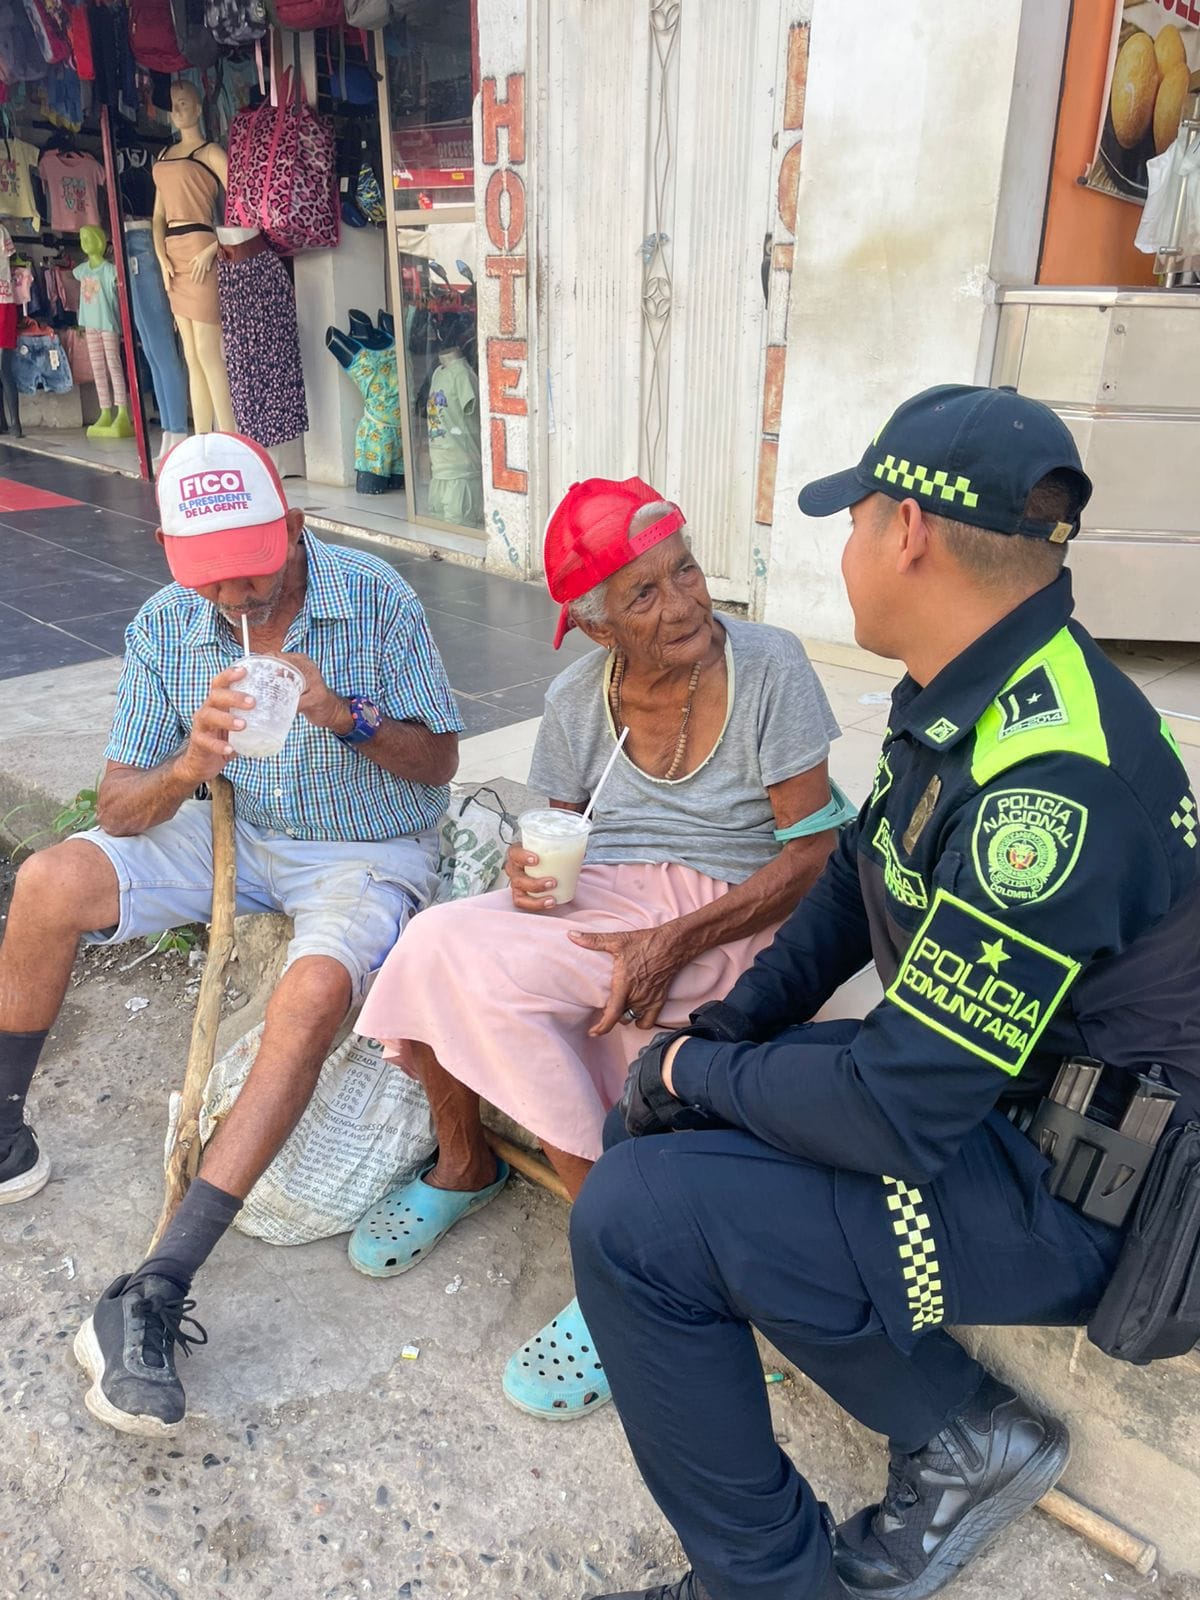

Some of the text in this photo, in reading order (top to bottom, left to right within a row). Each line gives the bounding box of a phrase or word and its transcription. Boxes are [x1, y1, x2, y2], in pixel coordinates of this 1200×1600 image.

[481, 72, 528, 495] HOTEL
[182, 472, 240, 499] FICO
[179, 492, 253, 512] EL PRESIDENTE
[185, 501, 249, 519] DE LA GENTE
[997, 795, 1073, 825] POLICÍA
[982, 810, 1074, 849] NACIONAL
[990, 883, 1039, 899] COLOMBIA
[913, 936, 1041, 1029] POLICIA
[902, 964, 1029, 1053] COMUNITARIA
